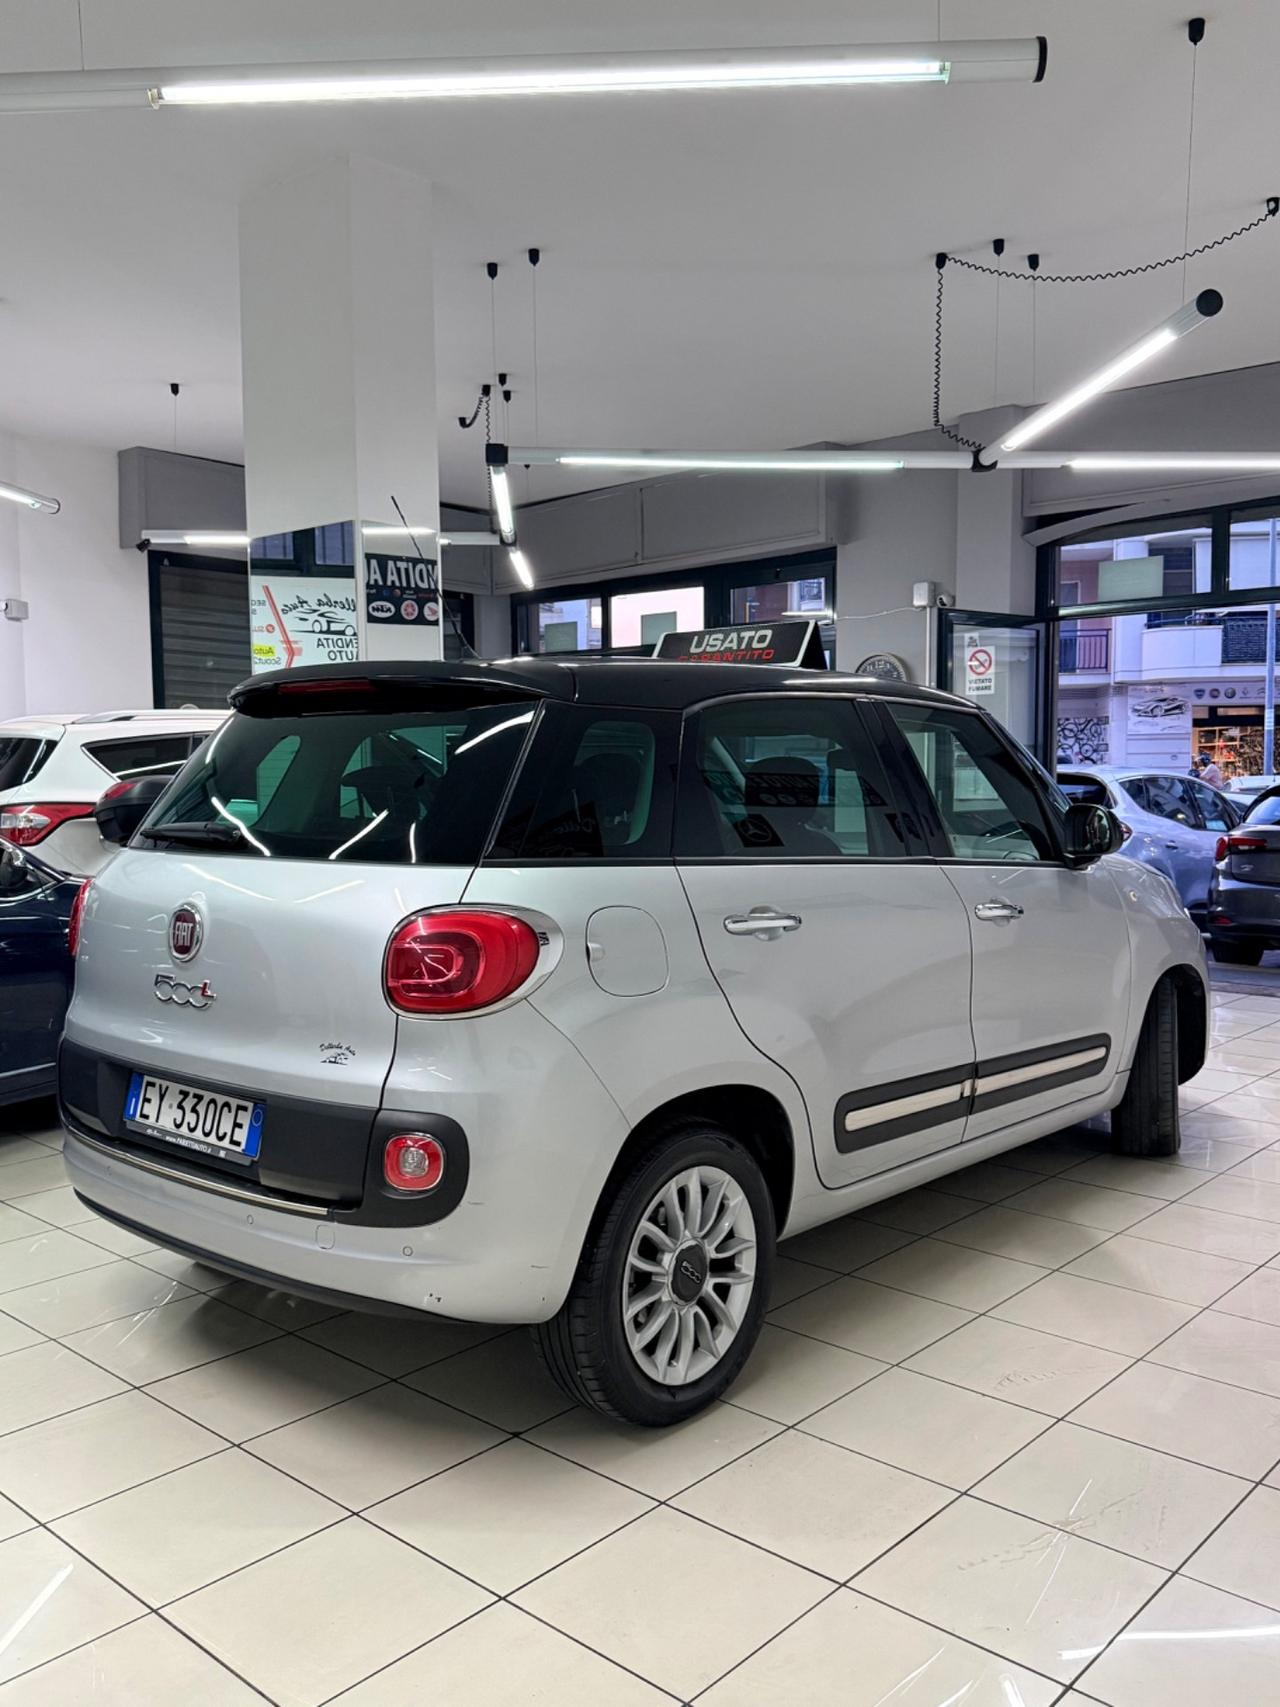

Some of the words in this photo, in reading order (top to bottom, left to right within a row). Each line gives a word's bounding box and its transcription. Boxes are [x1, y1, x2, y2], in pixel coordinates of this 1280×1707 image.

[689, 629, 773, 654] USATO
[174, 921, 194, 946] FIAT
[139, 1080, 169, 1123] EY
[173, 1089, 249, 1147] 330CE
